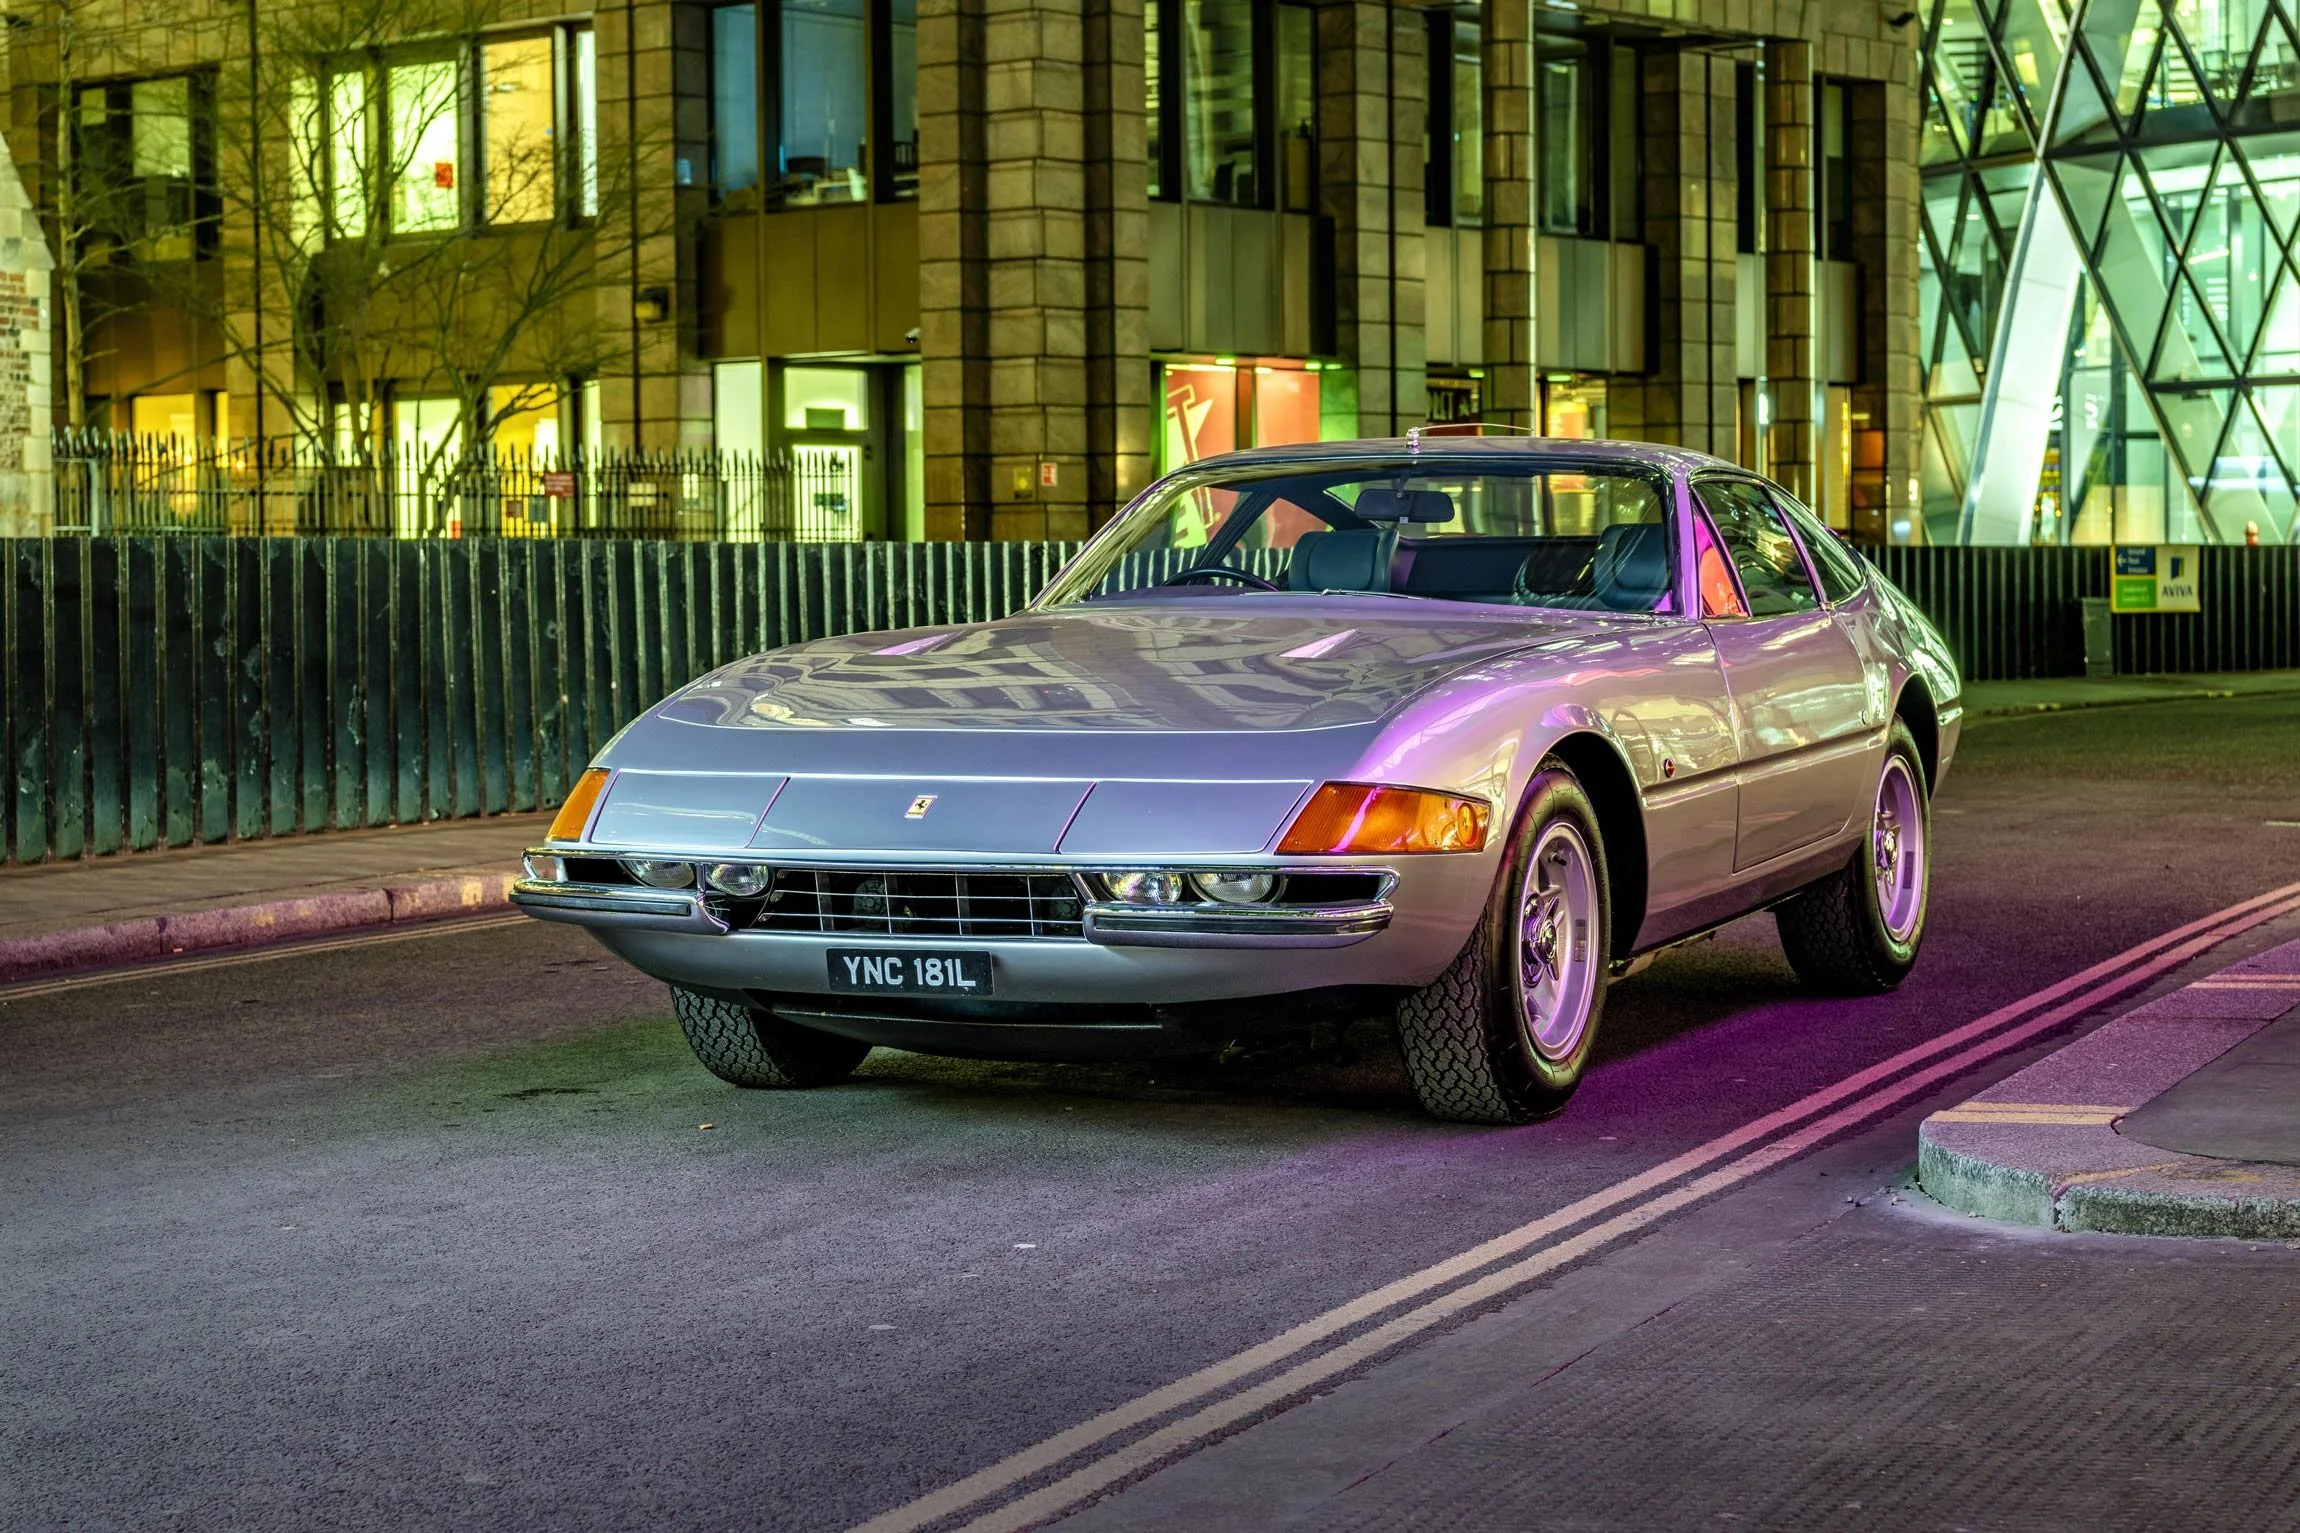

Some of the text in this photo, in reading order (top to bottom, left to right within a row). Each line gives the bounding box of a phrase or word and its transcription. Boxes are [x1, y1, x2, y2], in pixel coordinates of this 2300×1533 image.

[2162, 585, 2193, 597] AVIVA
[843, 956, 976, 987] YNC 181L
